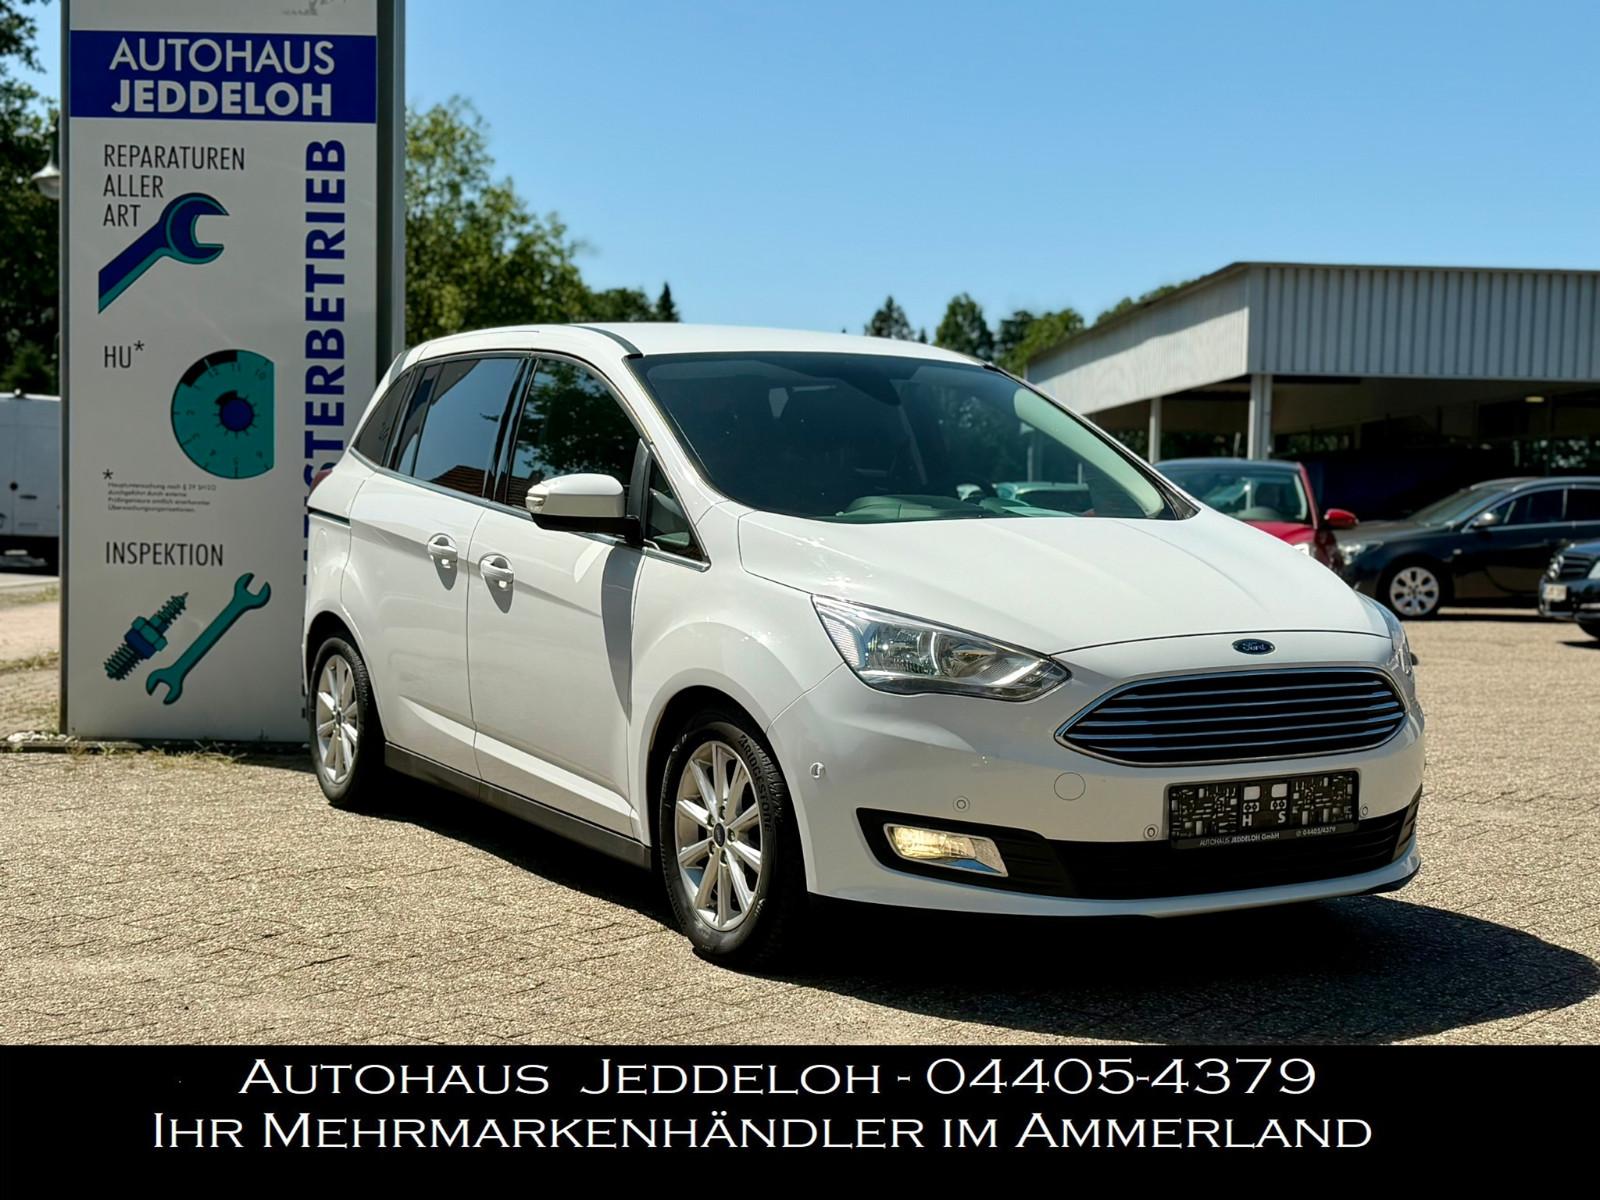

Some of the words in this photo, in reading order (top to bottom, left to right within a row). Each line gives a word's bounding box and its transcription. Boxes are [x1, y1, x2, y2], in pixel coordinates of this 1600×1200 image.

[110, 38, 335, 75] AUTOHAUS
[111, 80, 332, 116] JEDDELOH
[104, 143, 245, 170] REPARATUREN
[103, 173, 164, 198] ALLER
[103, 203, 142, 227] ART
[303, 139, 346, 587] TERBETRIEB
[106, 541, 224, 567] INSPEKTION
[738, 734, 773, 832] BRIDGESTONE
[1200, 836, 1231, 848] AUTOHAUS
[1231, 832, 1260, 844] JEDDELOH
[1261, 830, 1280, 841] GmbH
